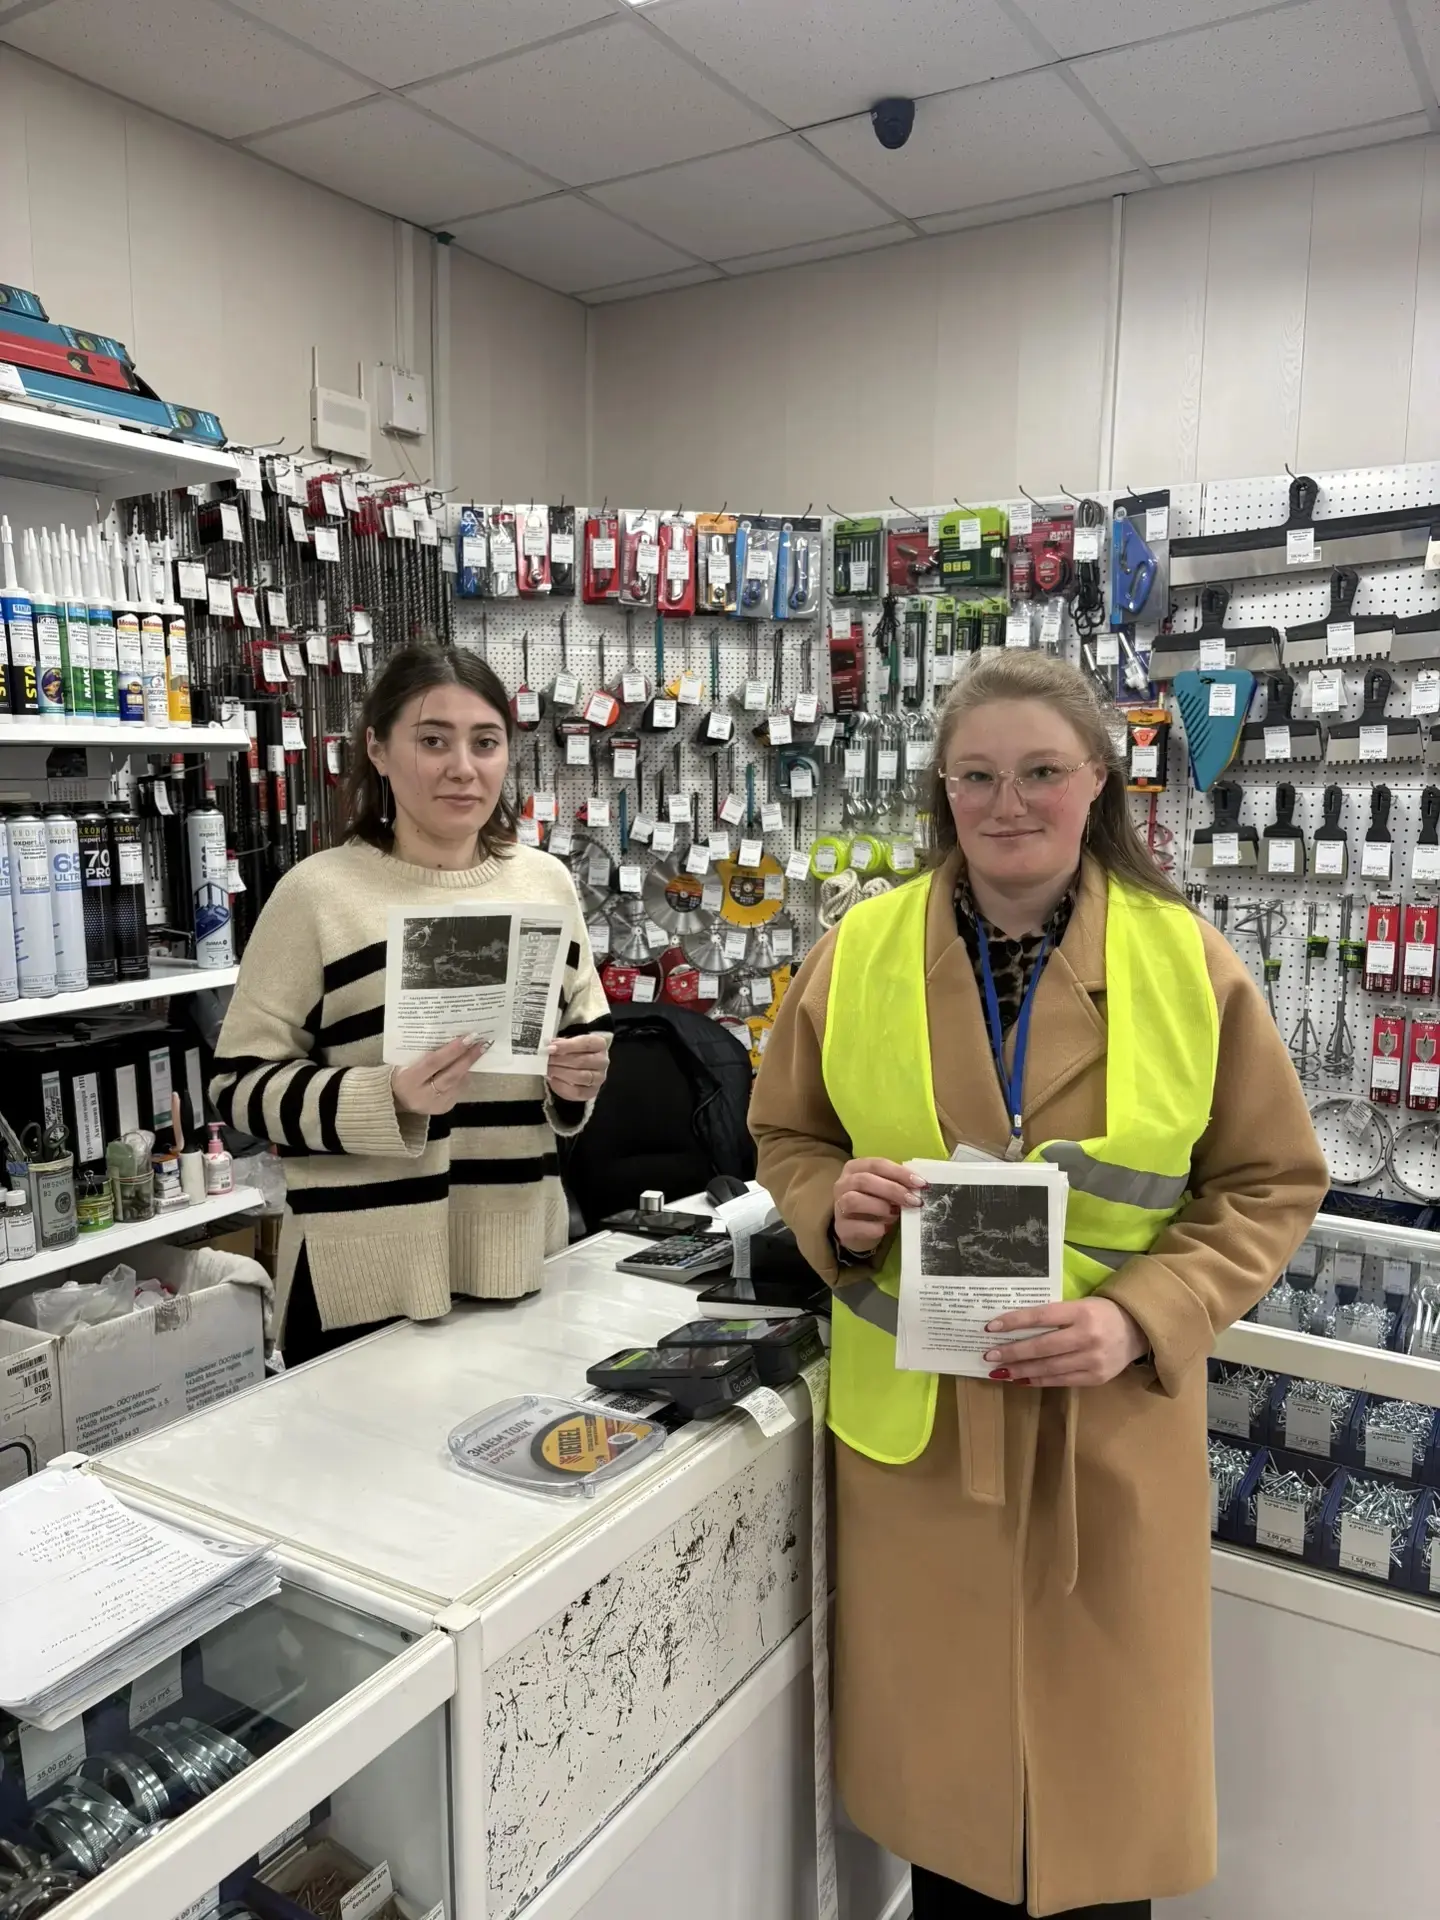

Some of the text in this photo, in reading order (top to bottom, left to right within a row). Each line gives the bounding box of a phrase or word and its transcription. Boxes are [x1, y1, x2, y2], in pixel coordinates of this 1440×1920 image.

[53, 852, 80, 873] 65
[84, 849, 110, 868] 70
[85, 867, 111, 878] PRO
[467, 1418, 535, 1457] ЗНАЕМ ТОЛК
[36, 1753, 75, 1782] 35,00 руб.
[352, 1892, 371, 1910] бетона
